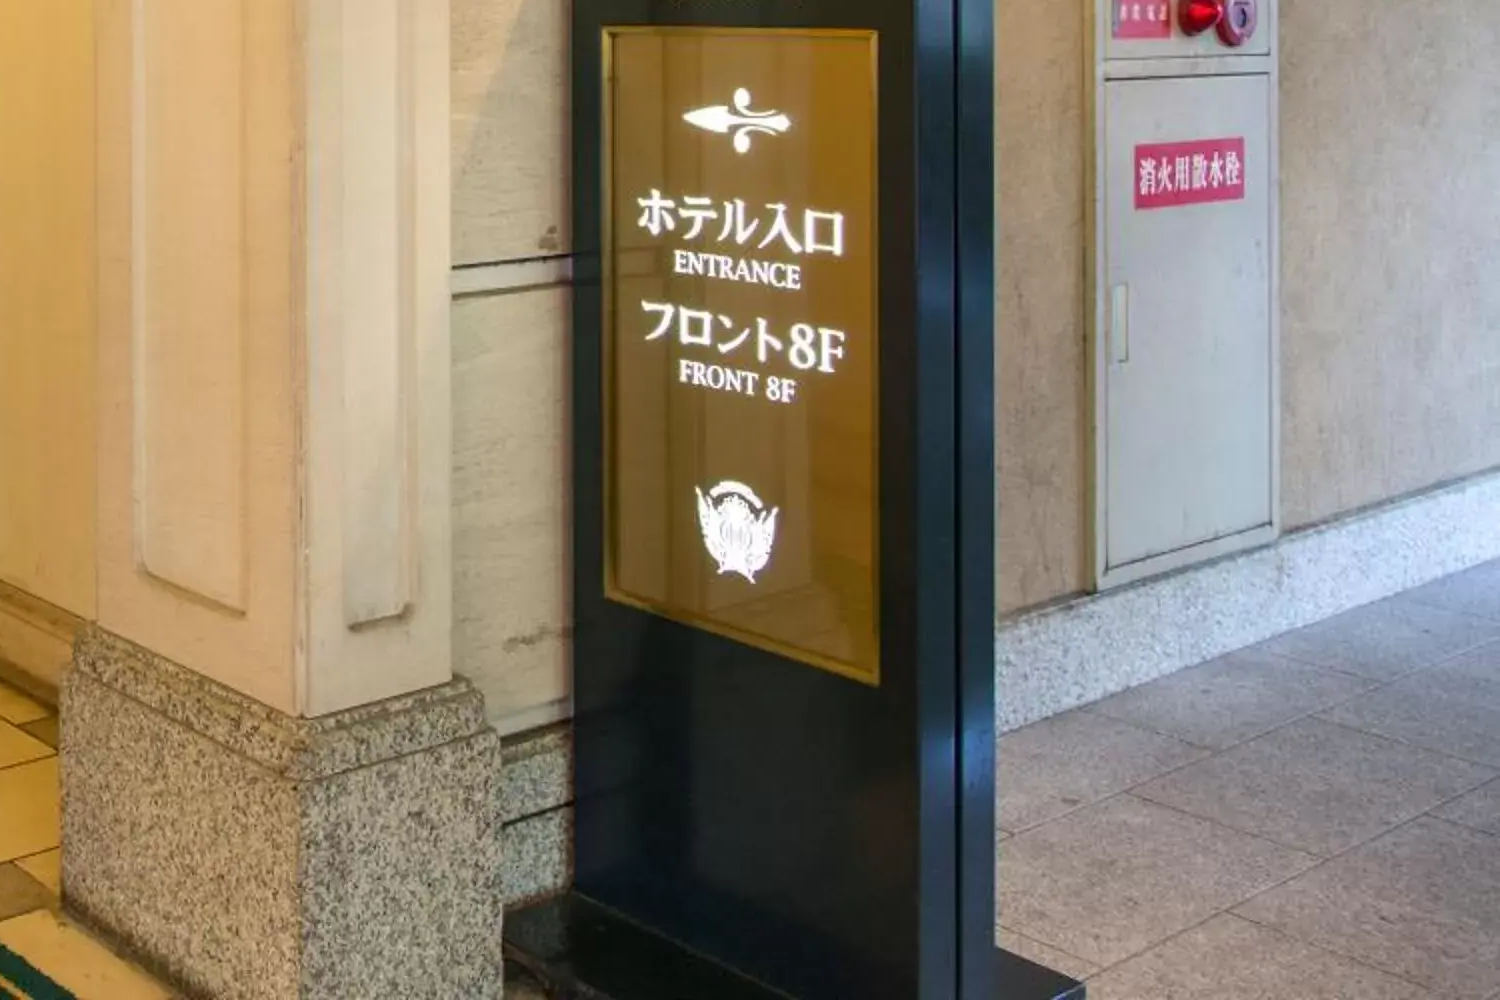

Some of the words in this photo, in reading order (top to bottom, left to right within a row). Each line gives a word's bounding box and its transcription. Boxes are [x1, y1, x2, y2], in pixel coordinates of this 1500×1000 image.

[1140, 151, 1241, 196] 消火用散水栓
[636, 188, 844, 257] ホテル入口
[673, 249, 802, 290] ENTRANCE
[640, 300, 846, 373] フロント8F
[678, 359, 760, 396] FRONT
[765, 376, 796, 403] 8F
